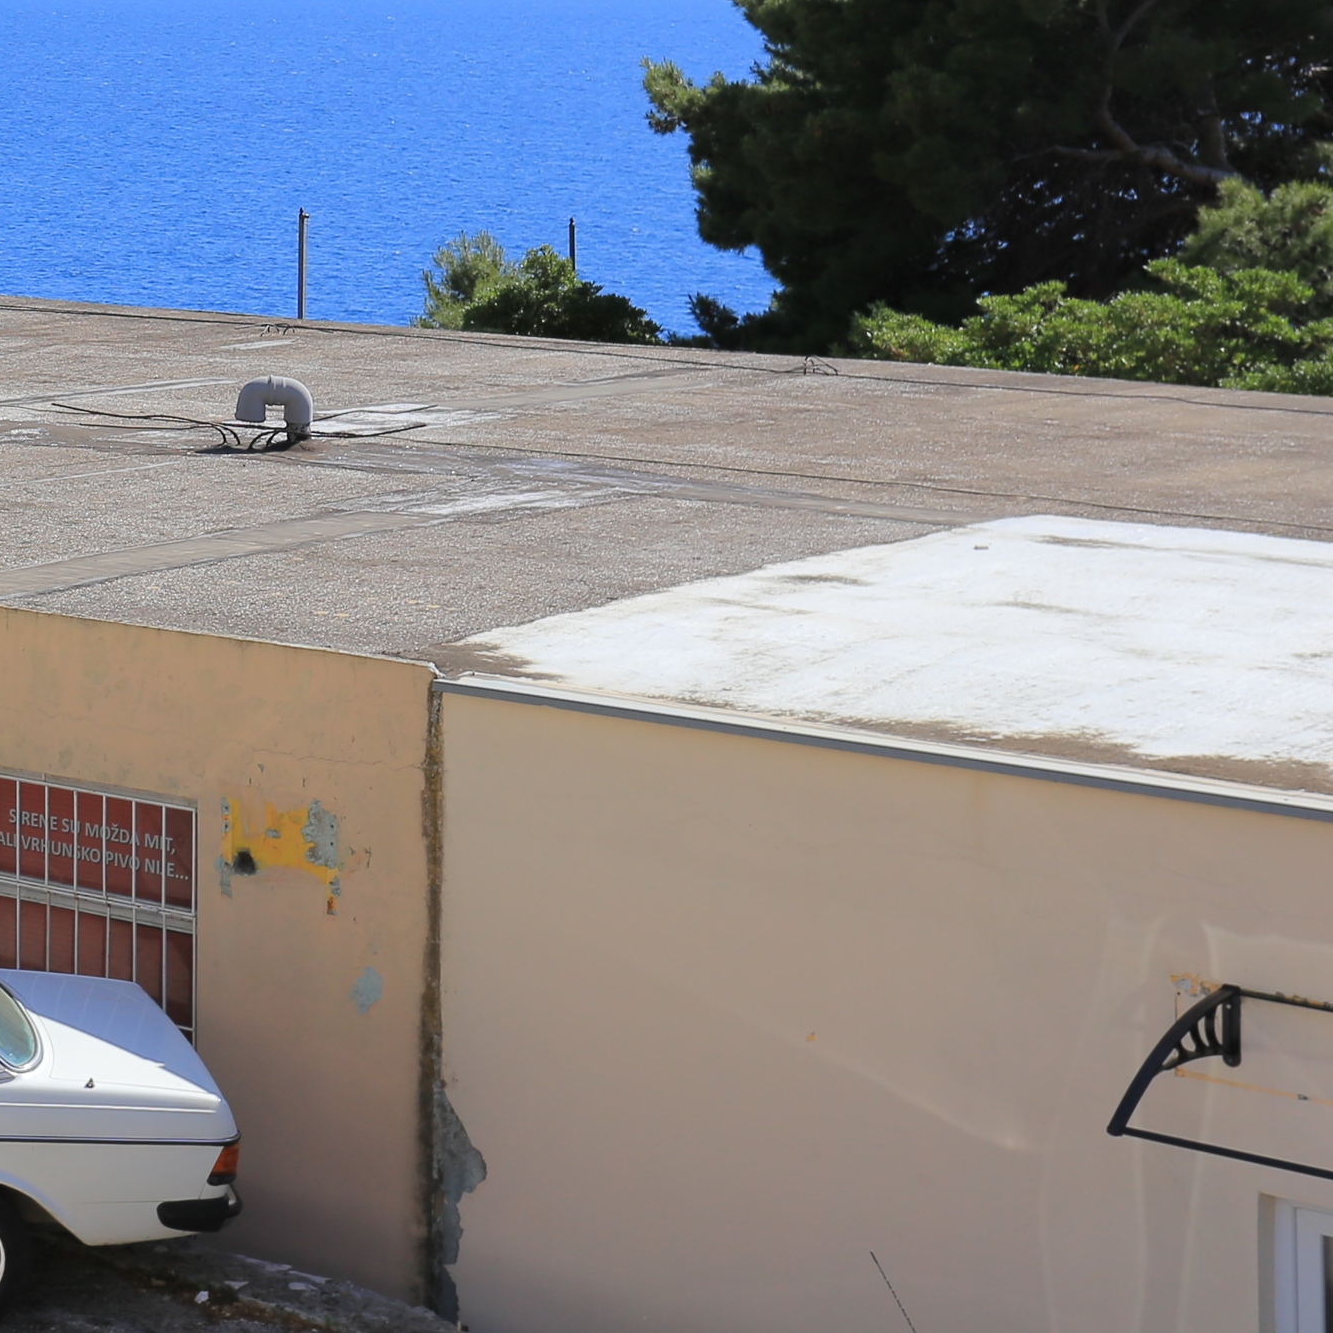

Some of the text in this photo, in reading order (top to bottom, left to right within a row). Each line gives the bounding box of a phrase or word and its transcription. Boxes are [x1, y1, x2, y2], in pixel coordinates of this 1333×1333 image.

[61, 818, 81, 835] SU
[85, 823, 140, 846] MOŽDA
[105, 850, 140, 871] PIVO
